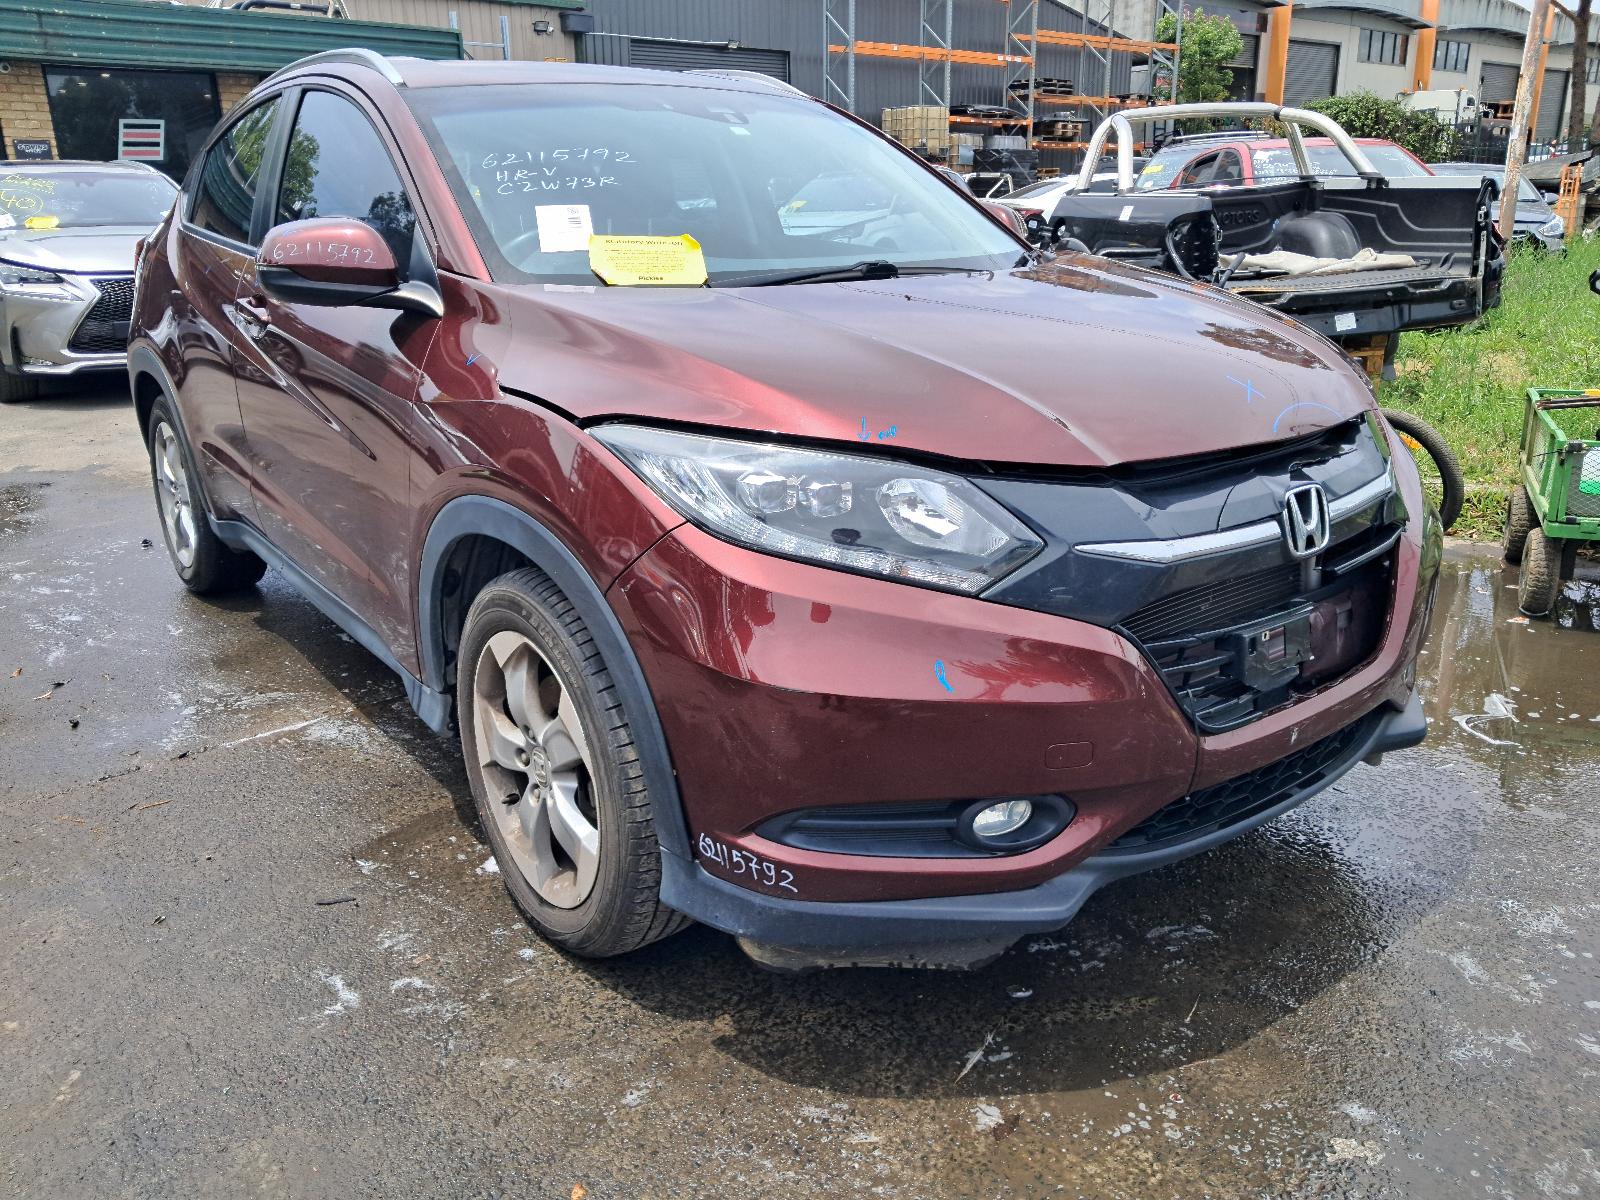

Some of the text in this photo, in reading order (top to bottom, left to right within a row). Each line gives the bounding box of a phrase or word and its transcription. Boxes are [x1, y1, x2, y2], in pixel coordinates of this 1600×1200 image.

[482, 148, 637, 169] 62115792
[273, 241, 377, 265] 62115792
[699, 832, 798, 893] 62115792
